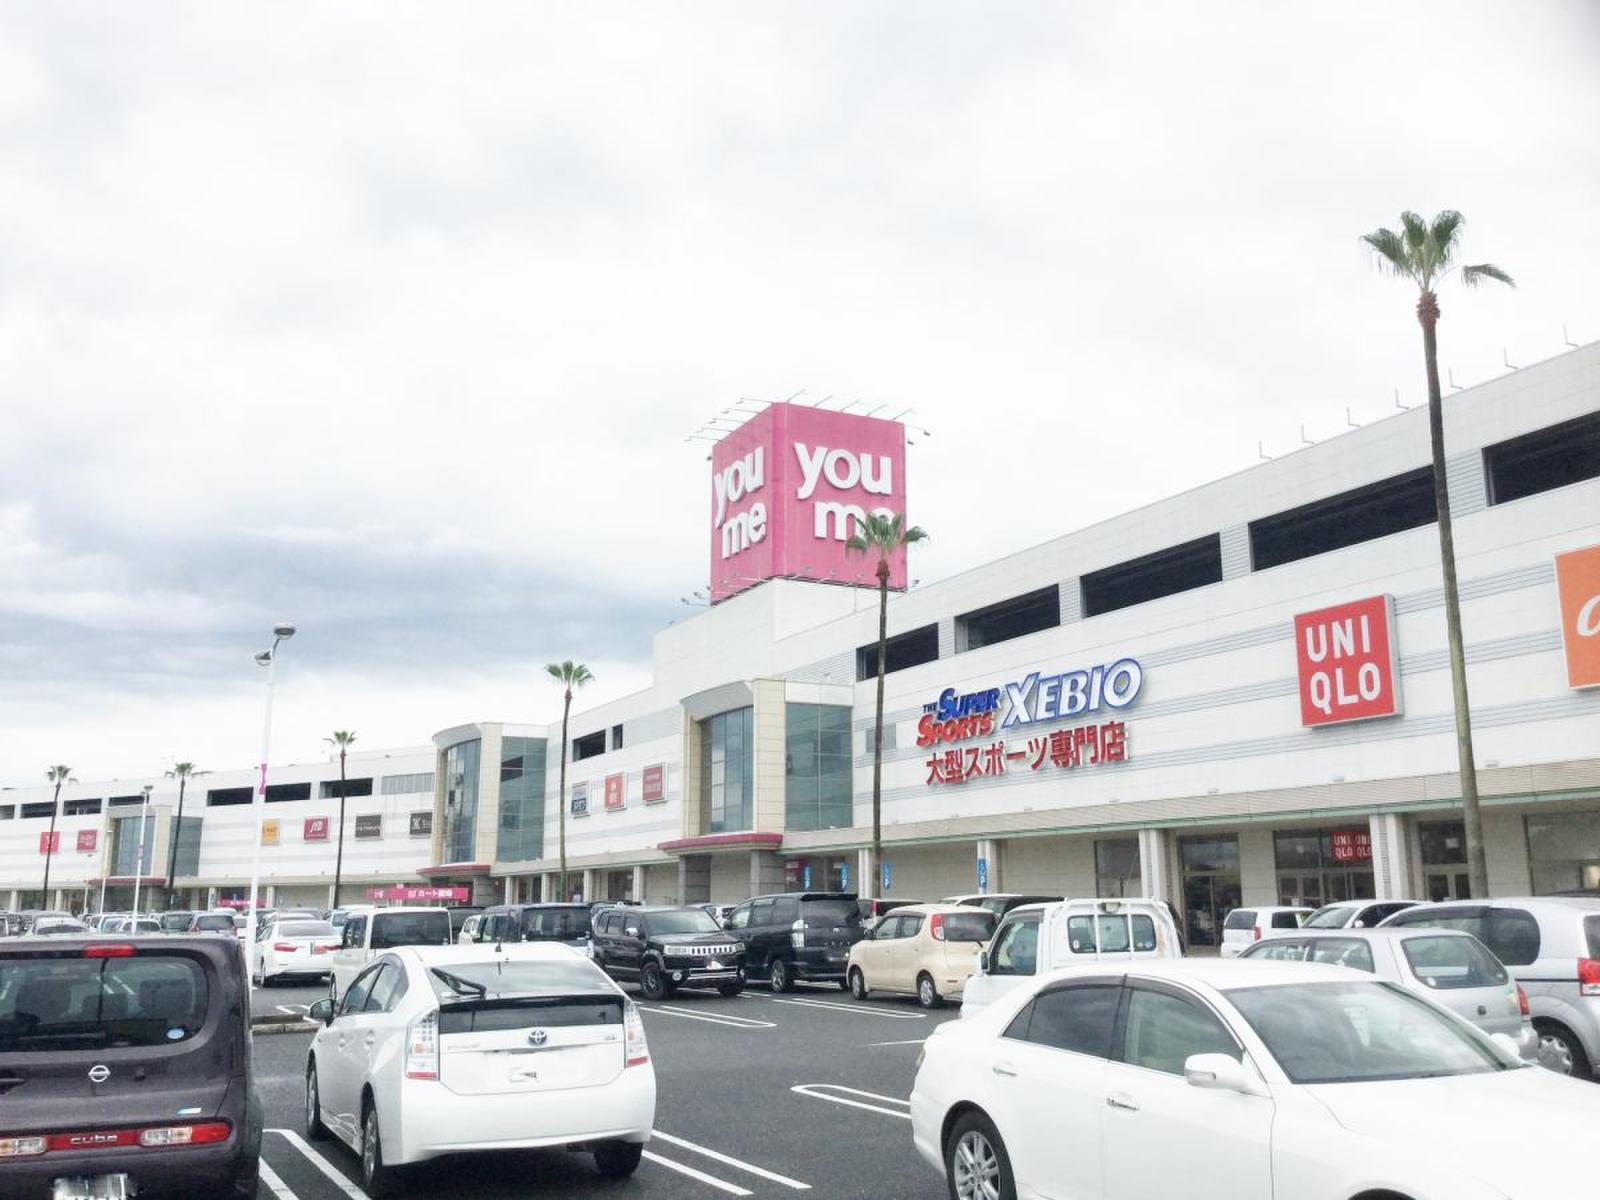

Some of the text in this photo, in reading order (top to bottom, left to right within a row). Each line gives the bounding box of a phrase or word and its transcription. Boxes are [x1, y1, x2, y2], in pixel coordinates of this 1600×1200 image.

[714, 446, 764, 528] you
[794, 443, 892, 499] you
[722, 503, 766, 559] me
[1306, 615, 1370, 662] UNI
[922, 702, 937, 713] THE
[1003, 659, 1142, 728] XEBIO
[1311, 663, 1380, 714] QLO
[926, 722, 1125, 785] 大型スポーツ専門店
[1334, 834, 1350, 845] UNI
[1335, 847, 1353, 858] QLO
[70, 1135, 118, 1144] cube
